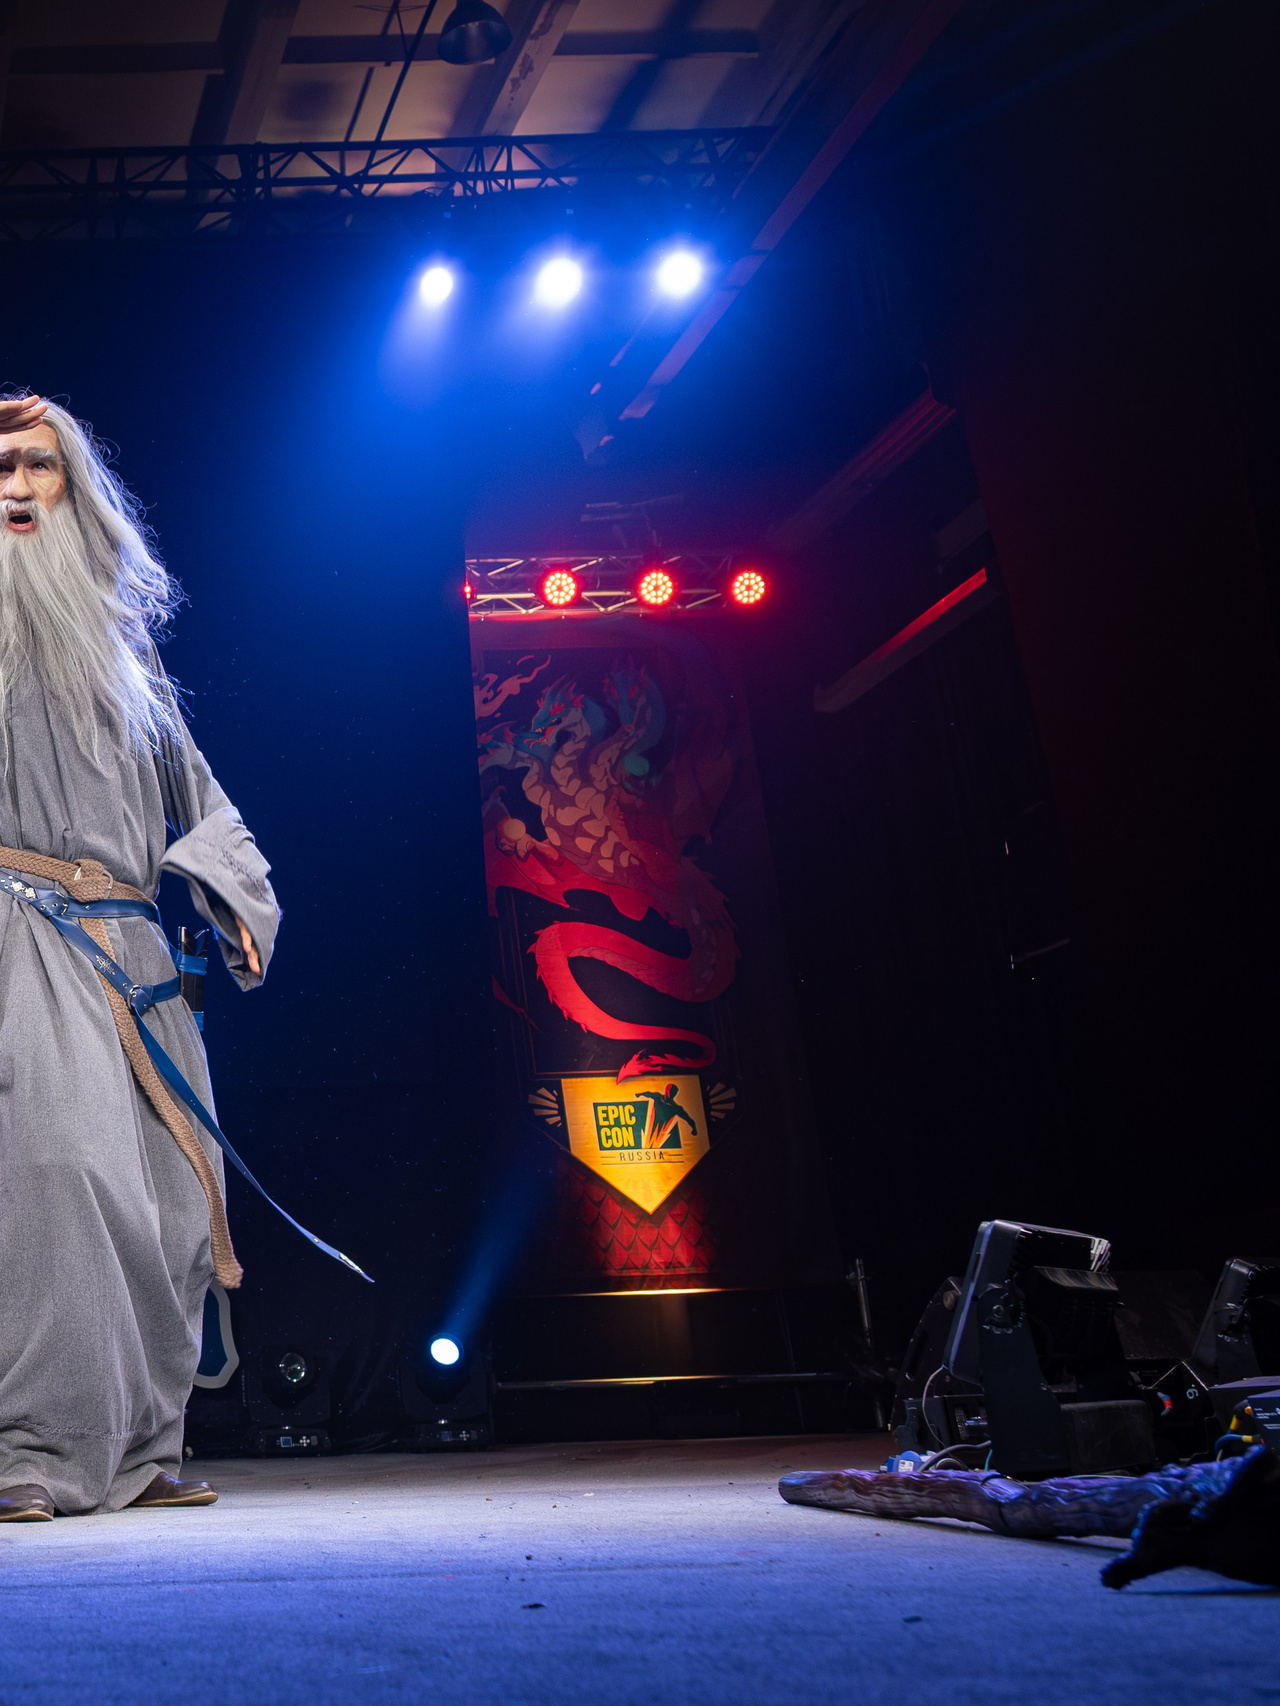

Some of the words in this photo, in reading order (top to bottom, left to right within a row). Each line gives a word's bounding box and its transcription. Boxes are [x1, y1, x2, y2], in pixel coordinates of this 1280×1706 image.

[597, 1104, 637, 1126] EPIC
[600, 1126, 635, 1148] CON
[619, 1150, 665, 1162] RUSSIA
